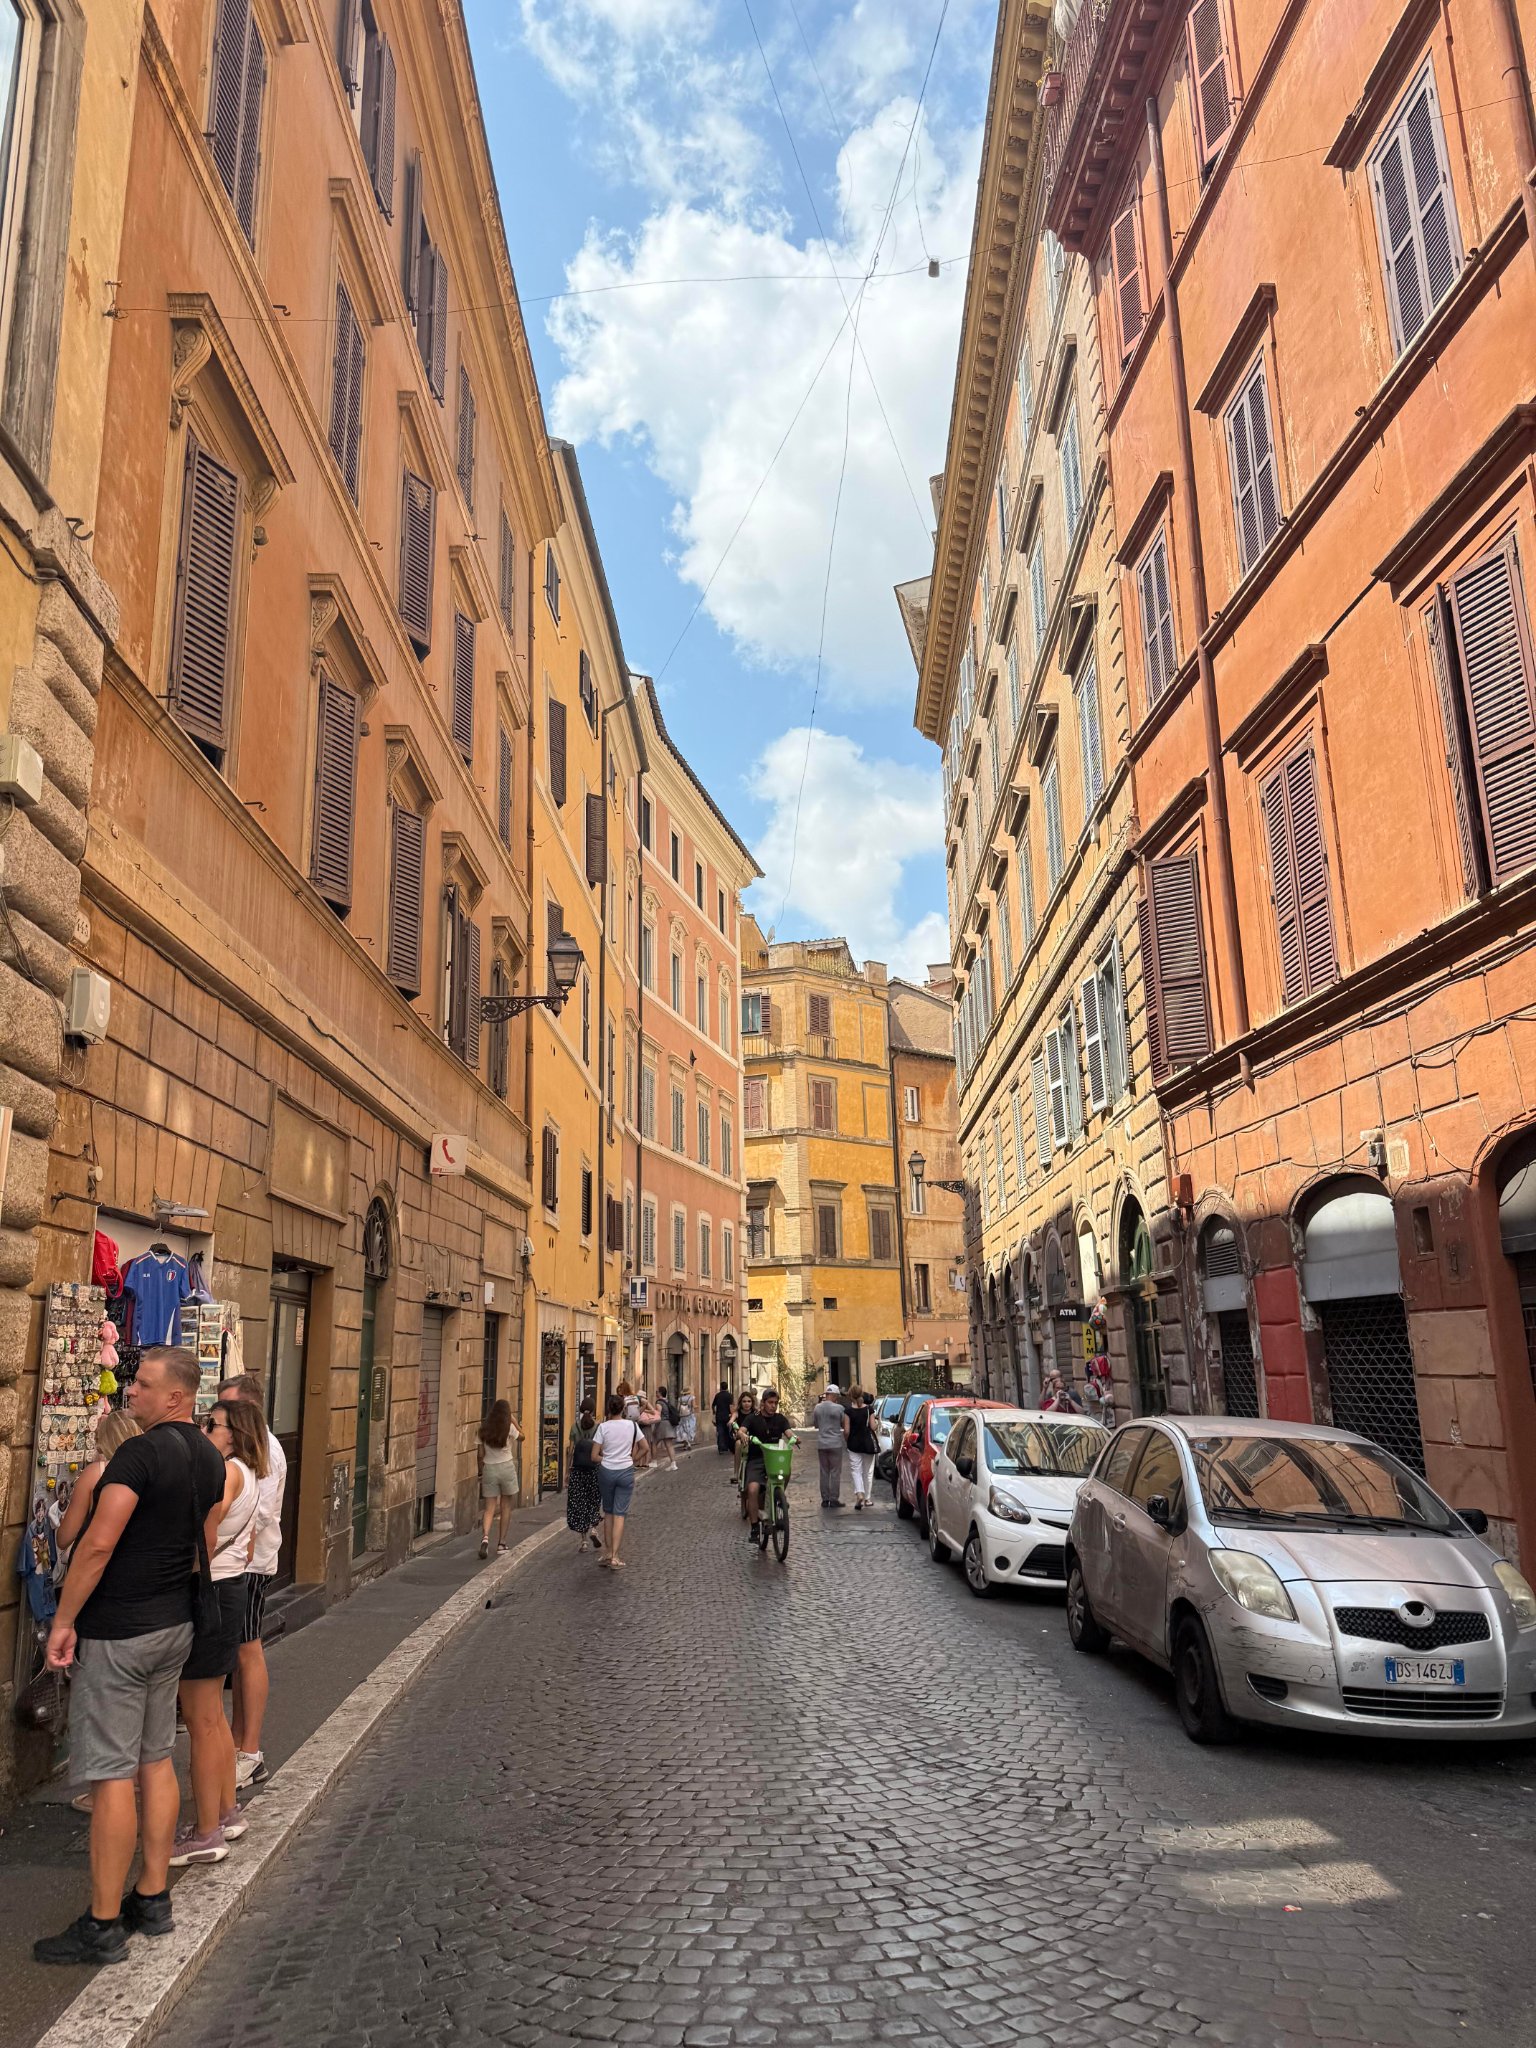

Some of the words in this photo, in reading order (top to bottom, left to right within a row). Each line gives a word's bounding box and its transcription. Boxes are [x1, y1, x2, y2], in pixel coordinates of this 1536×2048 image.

[632, 1278, 646, 1299] T
[657, 1288, 692, 1314] DITTA
[706, 1297, 735, 1317] POGGI
[1059, 1308, 1077, 1316] ATM
[1085, 1328, 1094, 1354] ATM
